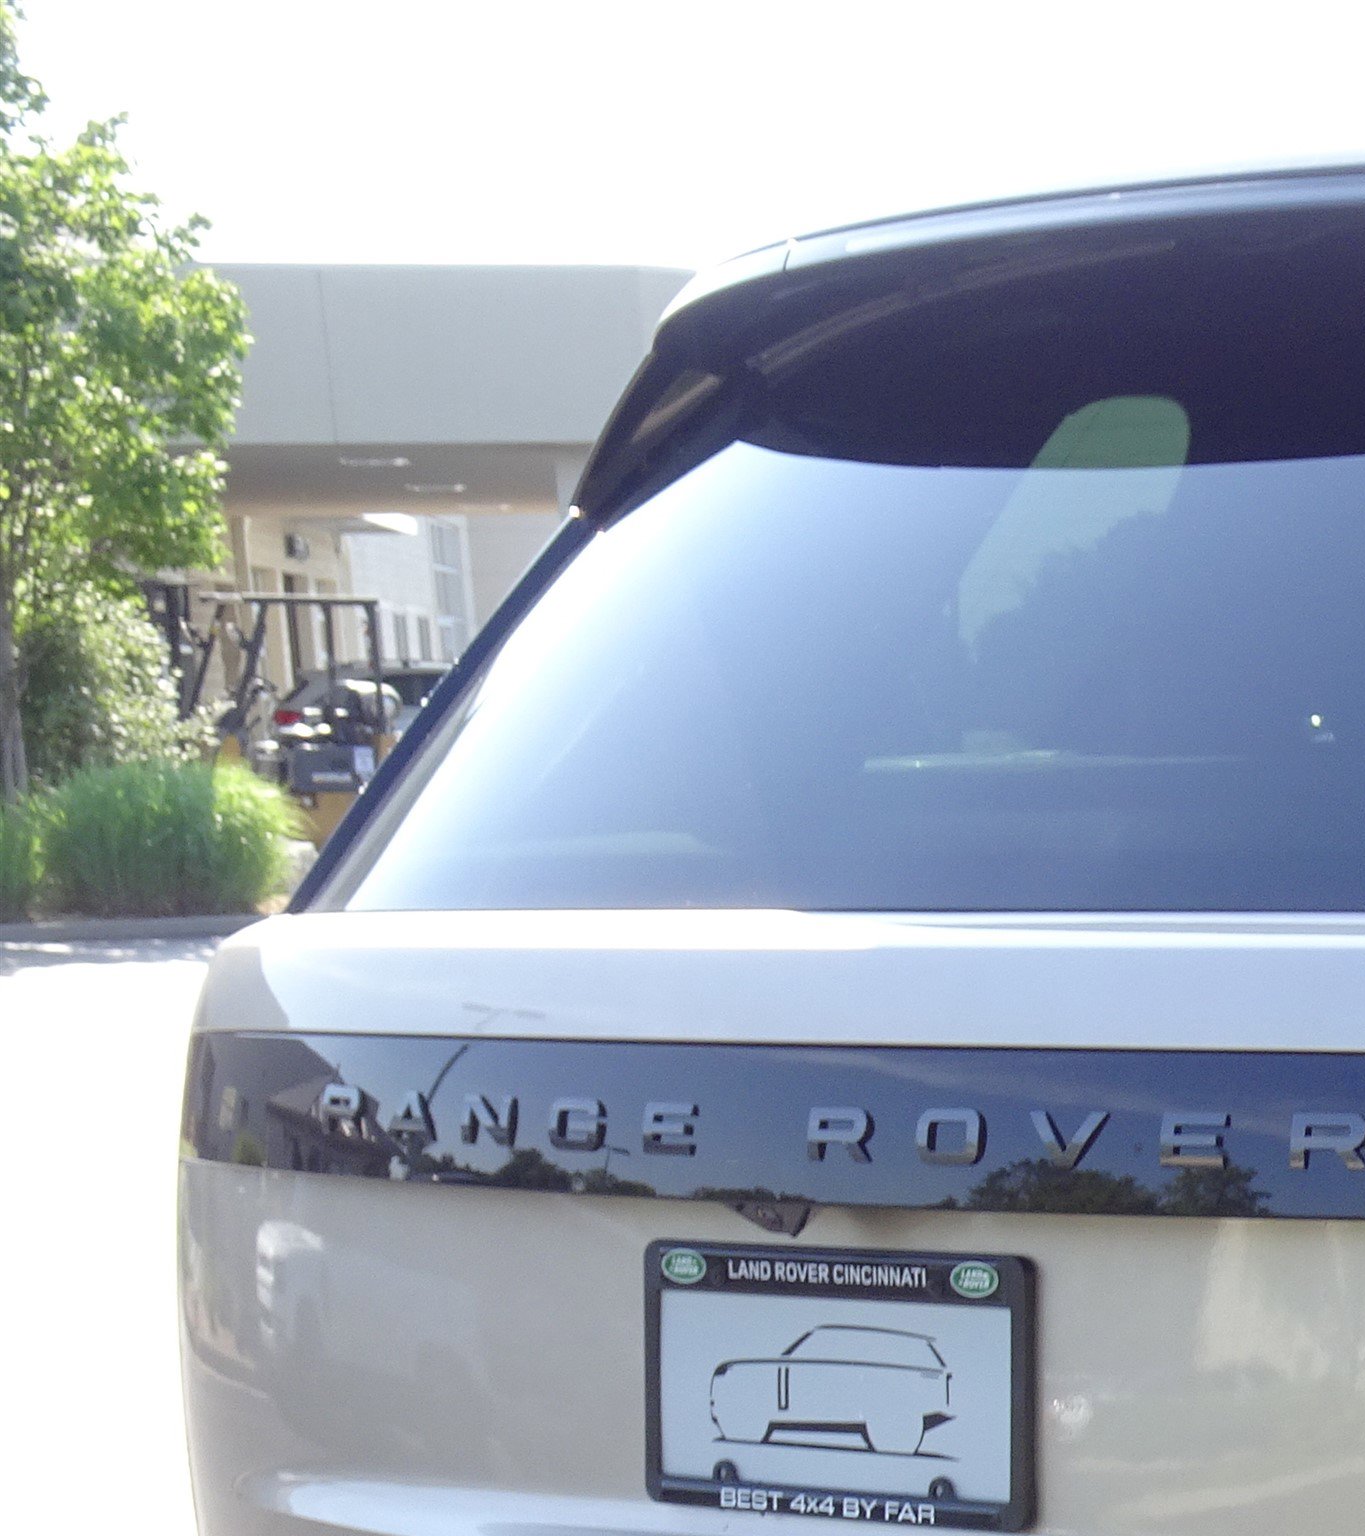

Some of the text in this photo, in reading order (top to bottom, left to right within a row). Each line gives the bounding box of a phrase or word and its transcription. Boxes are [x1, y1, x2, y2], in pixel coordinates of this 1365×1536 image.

[316, 1082, 699, 1157] RANGE
[728, 1259, 927, 1288] LAND ROVER CINCINNATI
[720, 1487, 783, 1511] BEST
[843, 1498, 876, 1519] BY
[884, 1503, 936, 1525] FAR
